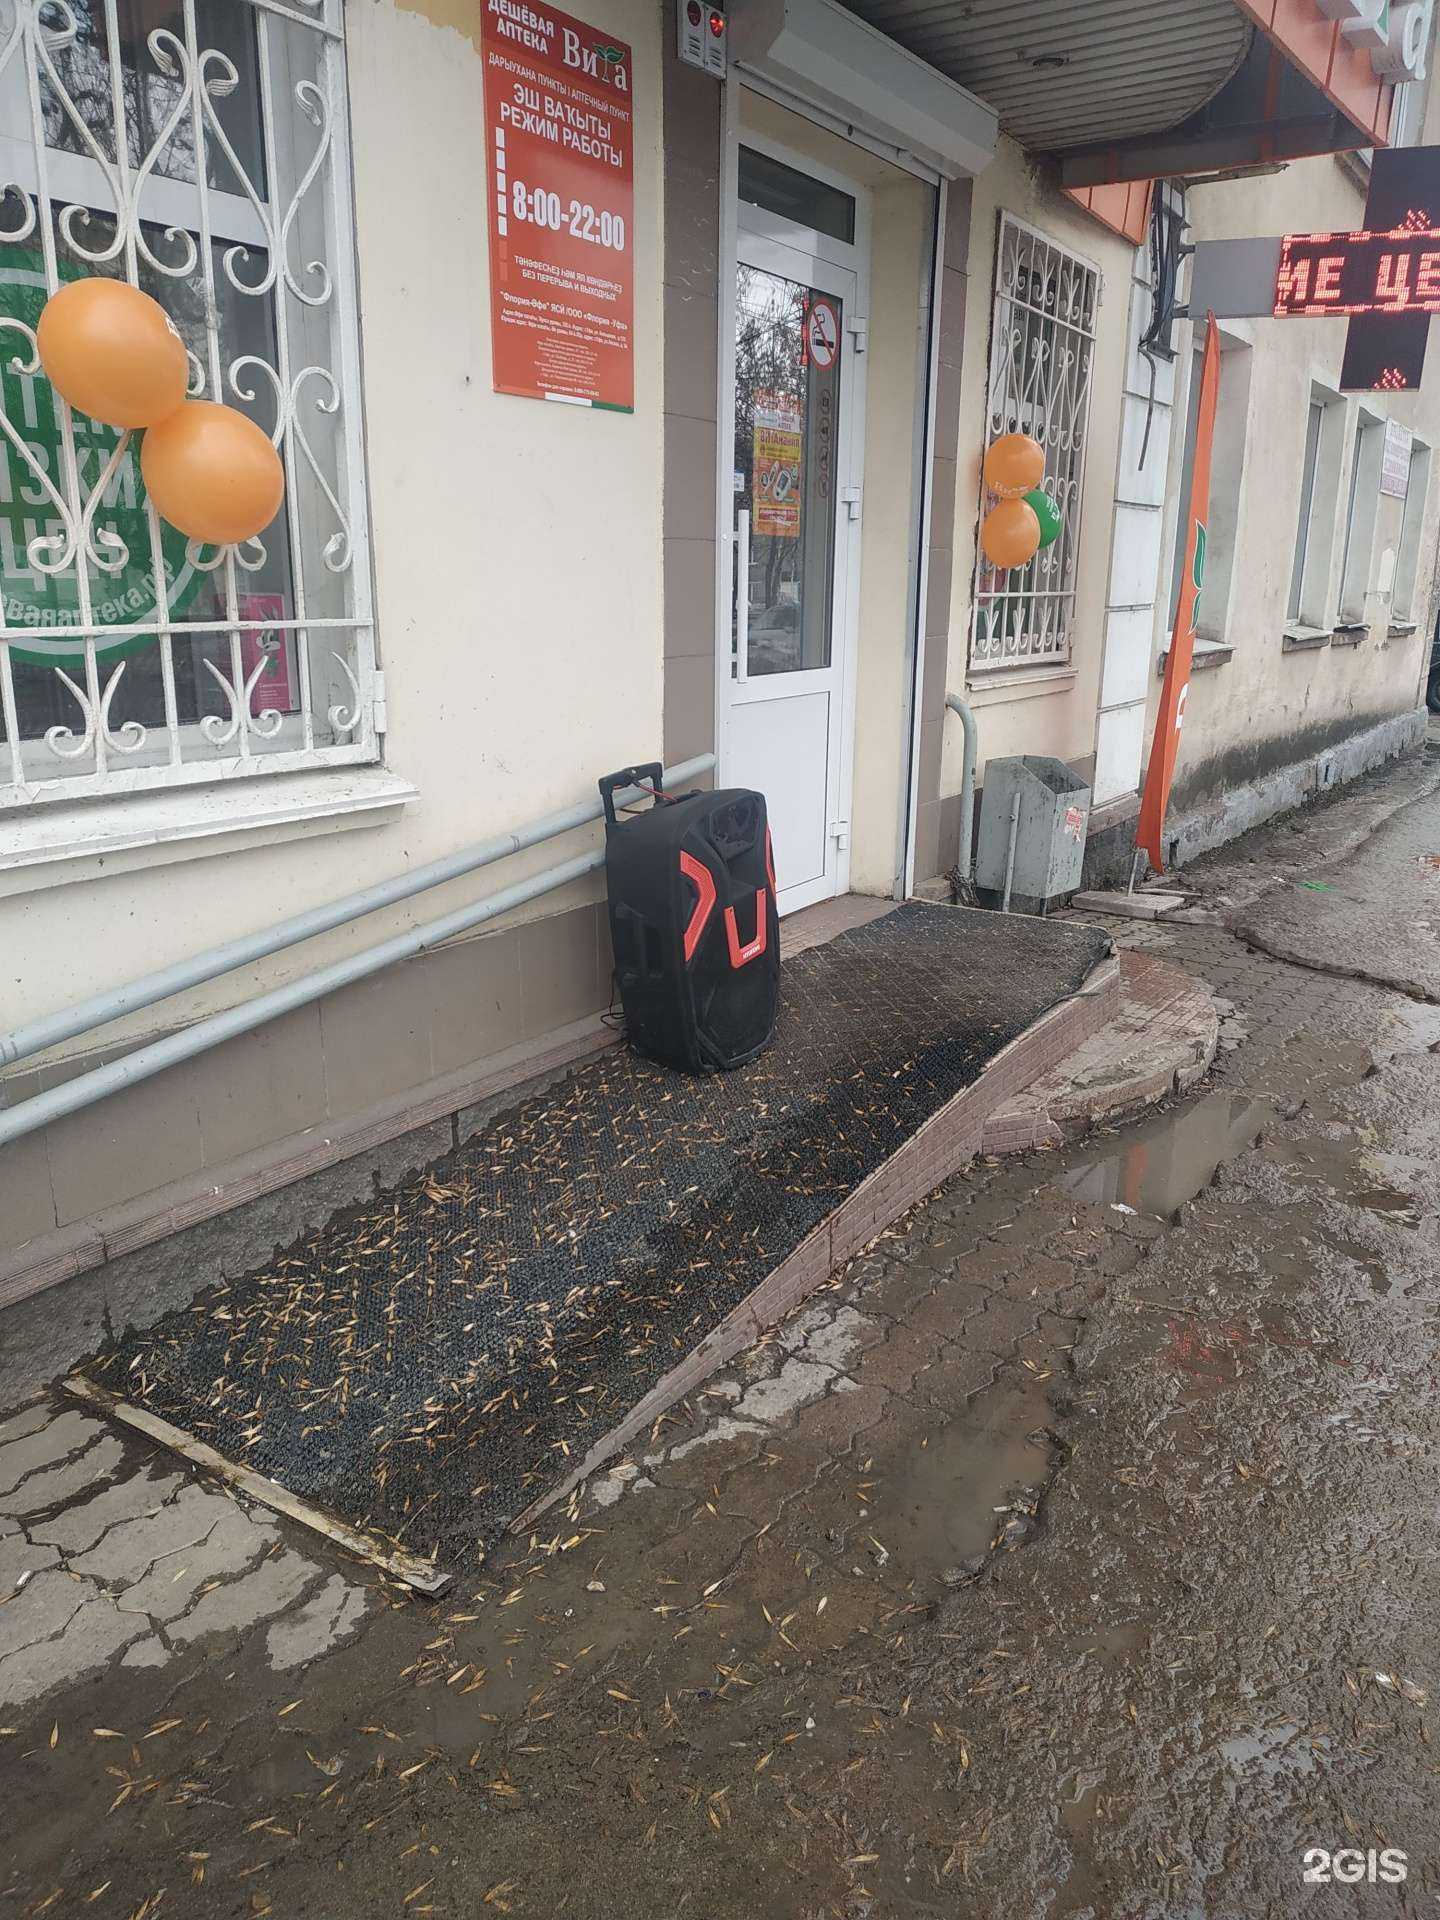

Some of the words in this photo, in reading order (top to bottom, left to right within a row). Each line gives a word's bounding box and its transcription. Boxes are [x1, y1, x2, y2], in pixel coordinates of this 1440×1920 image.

[489, 0, 554, 37] ДЕШЁВАЯ
[497, 18, 549, 54] АПТЕКА
[488, 52, 536, 81] ДАРЫУХАНА
[538, 73, 567, 96] ПУНКТЫ
[571, 89, 609, 113] АПТЕЧНЫЙ
[609, 103, 630, 121] ПУНКТ
[513, 82, 540, 111] ЭШ
[500, 101, 559, 142] РЕЖИМ
[562, 129, 623, 167] РАБОТЫ
[513, 181, 625, 251] 8:00-22:00
[522, 269, 535, 280] БЕЗ
[537, 272, 574, 289] ПЕРЕРЫВА
[574, 283, 579, 291] И
[580, 285, 617, 300] ВЫХОДНЫХ
